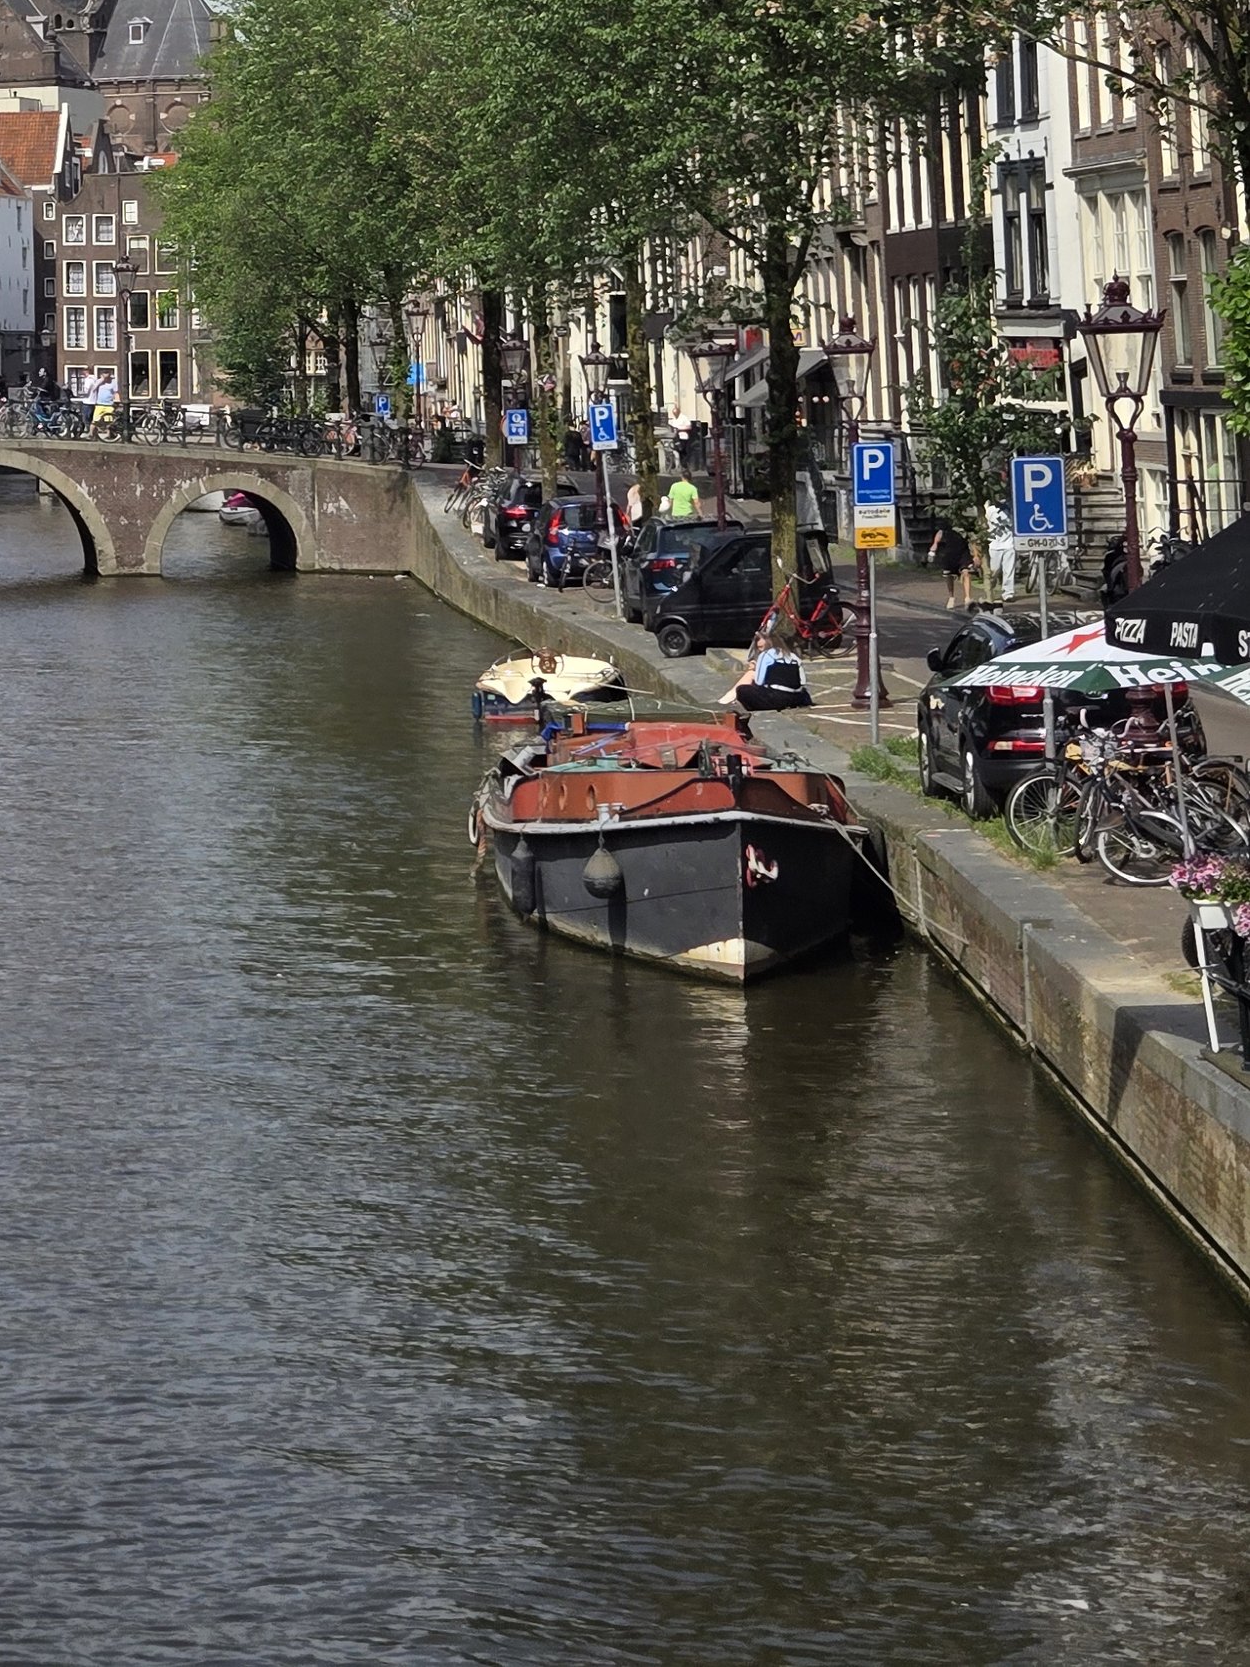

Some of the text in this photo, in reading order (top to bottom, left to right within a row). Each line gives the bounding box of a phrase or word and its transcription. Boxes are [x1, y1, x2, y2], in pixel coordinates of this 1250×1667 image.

[595, 407, 609, 427] P
[863, 449, 885, 481] P
[1023, 464, 1053, 502] P
[1114, 617, 1147, 644] PIZZA
[1170, 621, 1199, 648] PASTA
[952, 665, 1085, 688] Heineken
